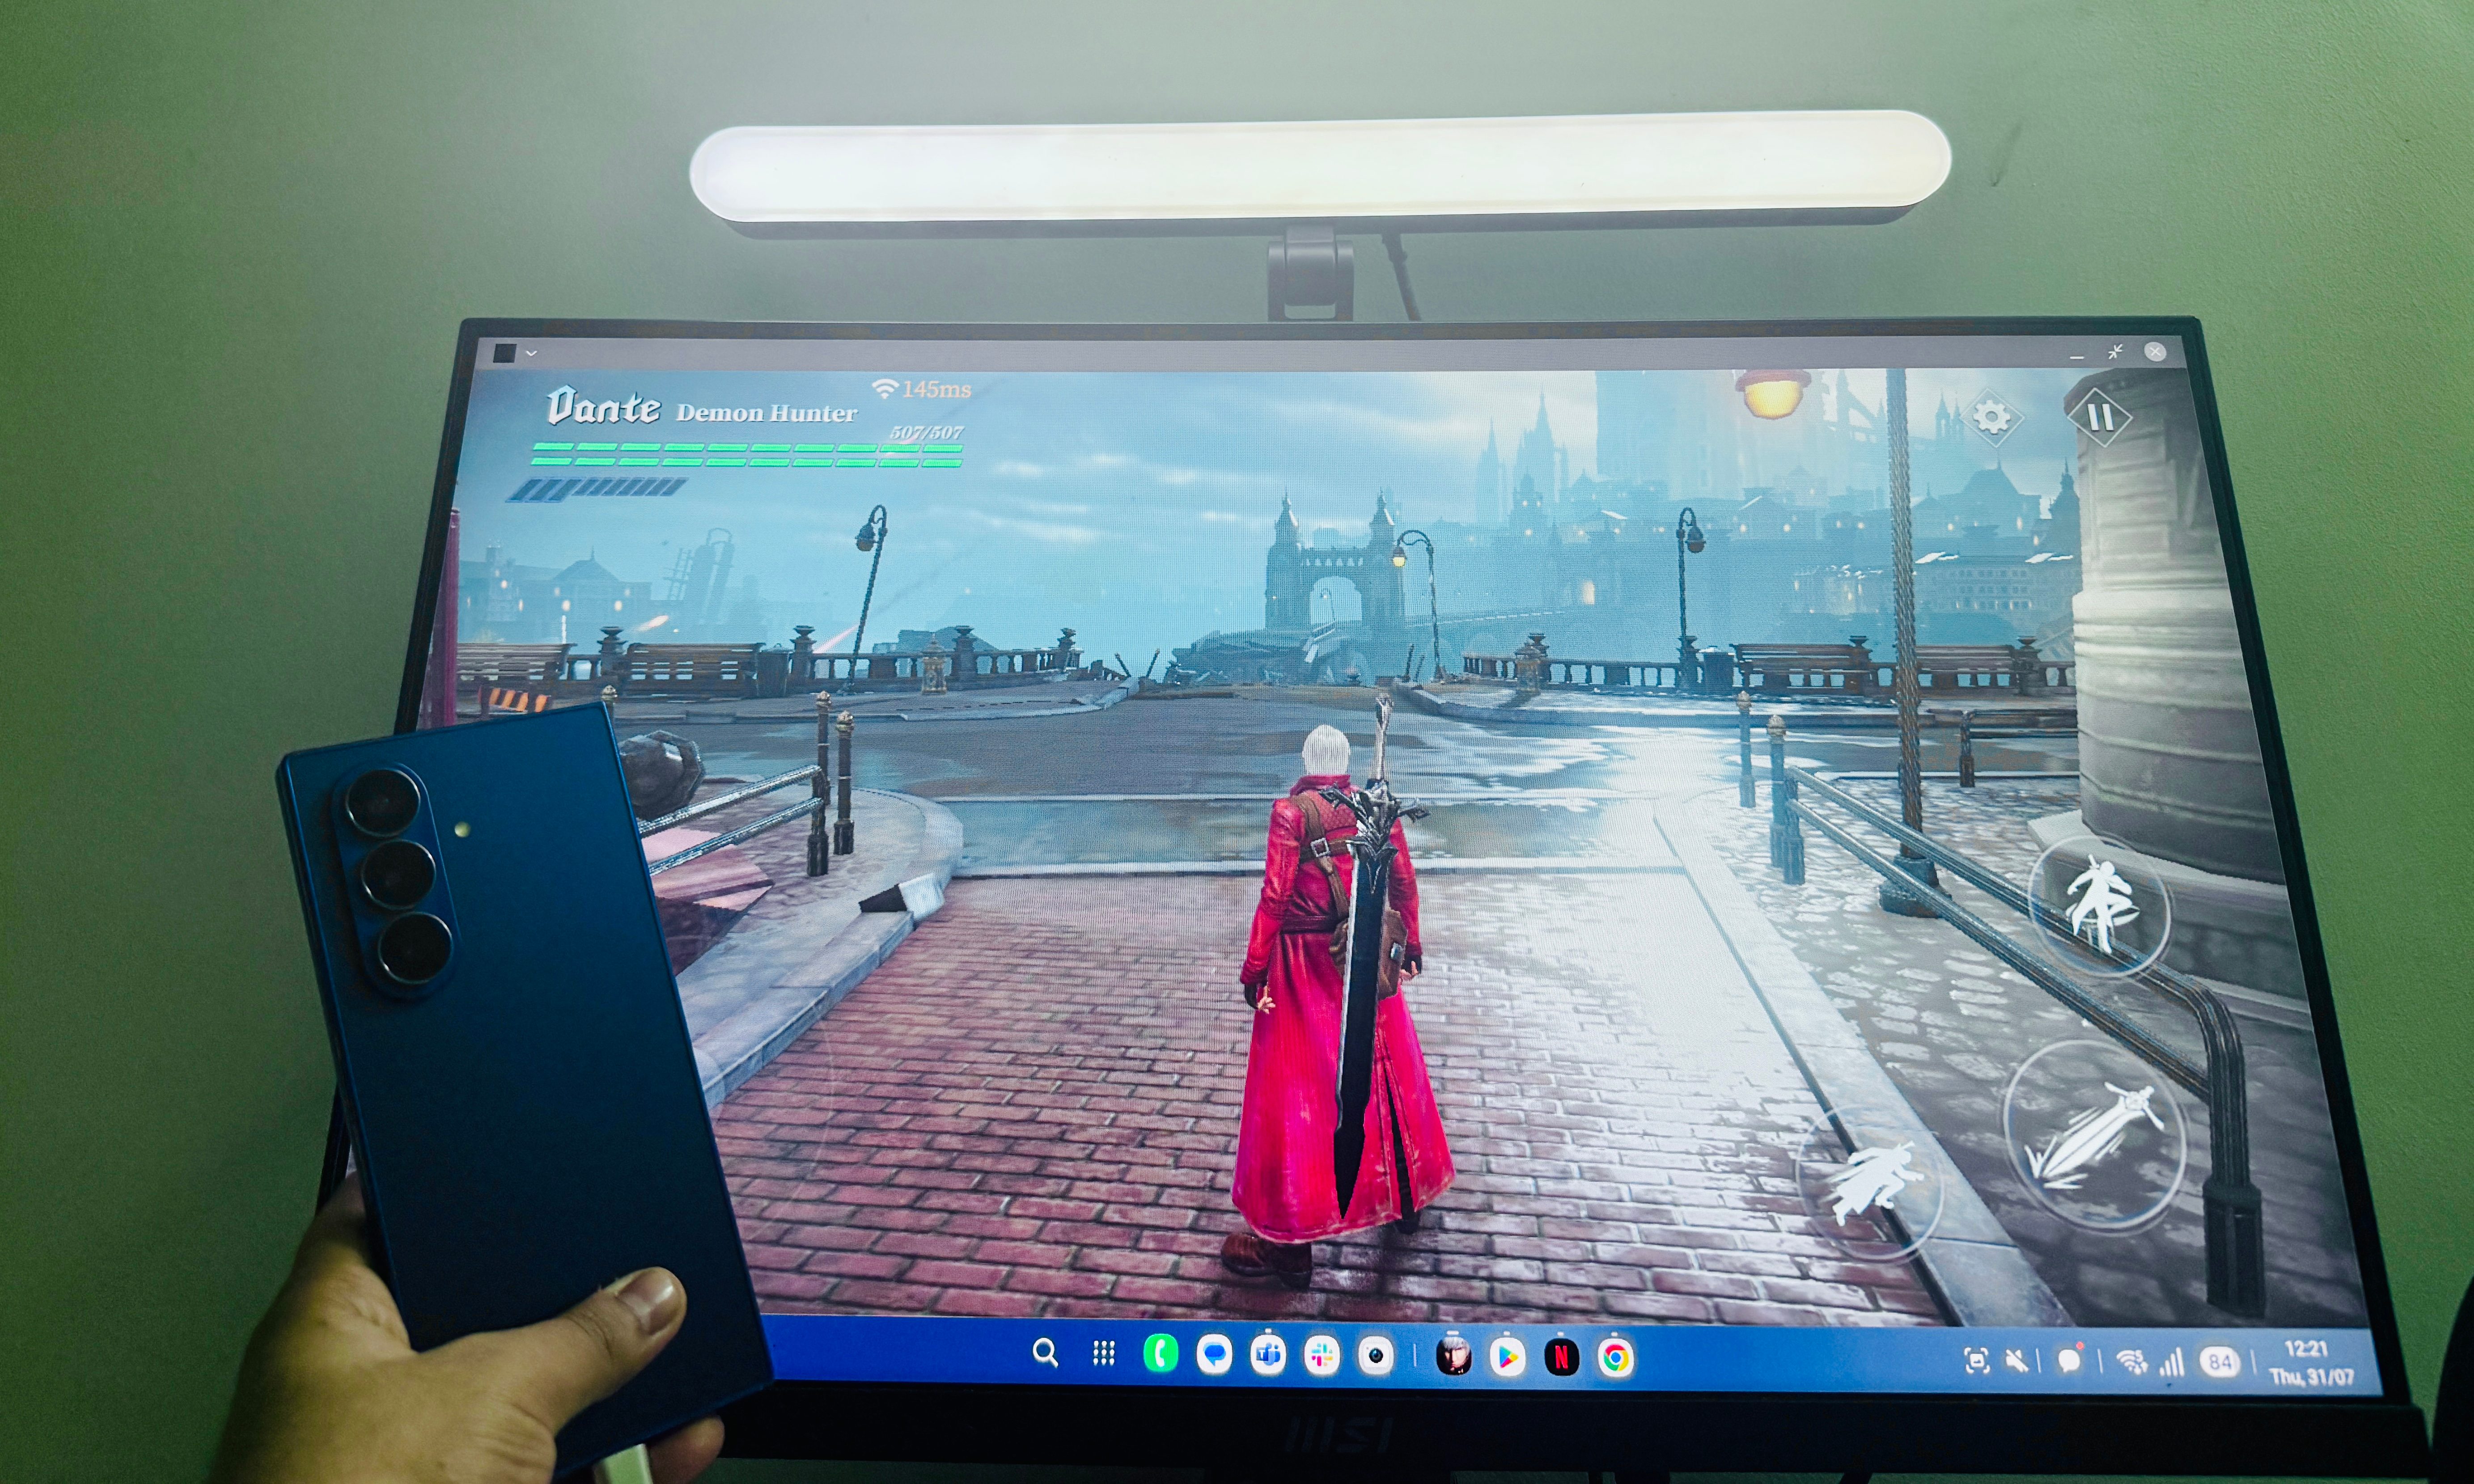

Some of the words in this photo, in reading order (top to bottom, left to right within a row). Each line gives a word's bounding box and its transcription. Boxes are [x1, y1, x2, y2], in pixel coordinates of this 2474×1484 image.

[903, 380, 972, 398] 145ms
[546, 384, 662, 426] Dante
[675, 403, 765, 422] Demon
[769, 403, 859, 423] Hunter
[890, 425, 966, 440] 507/507
[2284, 1340, 2328, 1357] 12:21
[2209, 1354, 2232, 1370] 84
[2268, 1367, 2306, 1388] Thu,
[2307, 1367, 2355, 1387] 31/07
[1284, 1416, 1395, 1453] MSI
